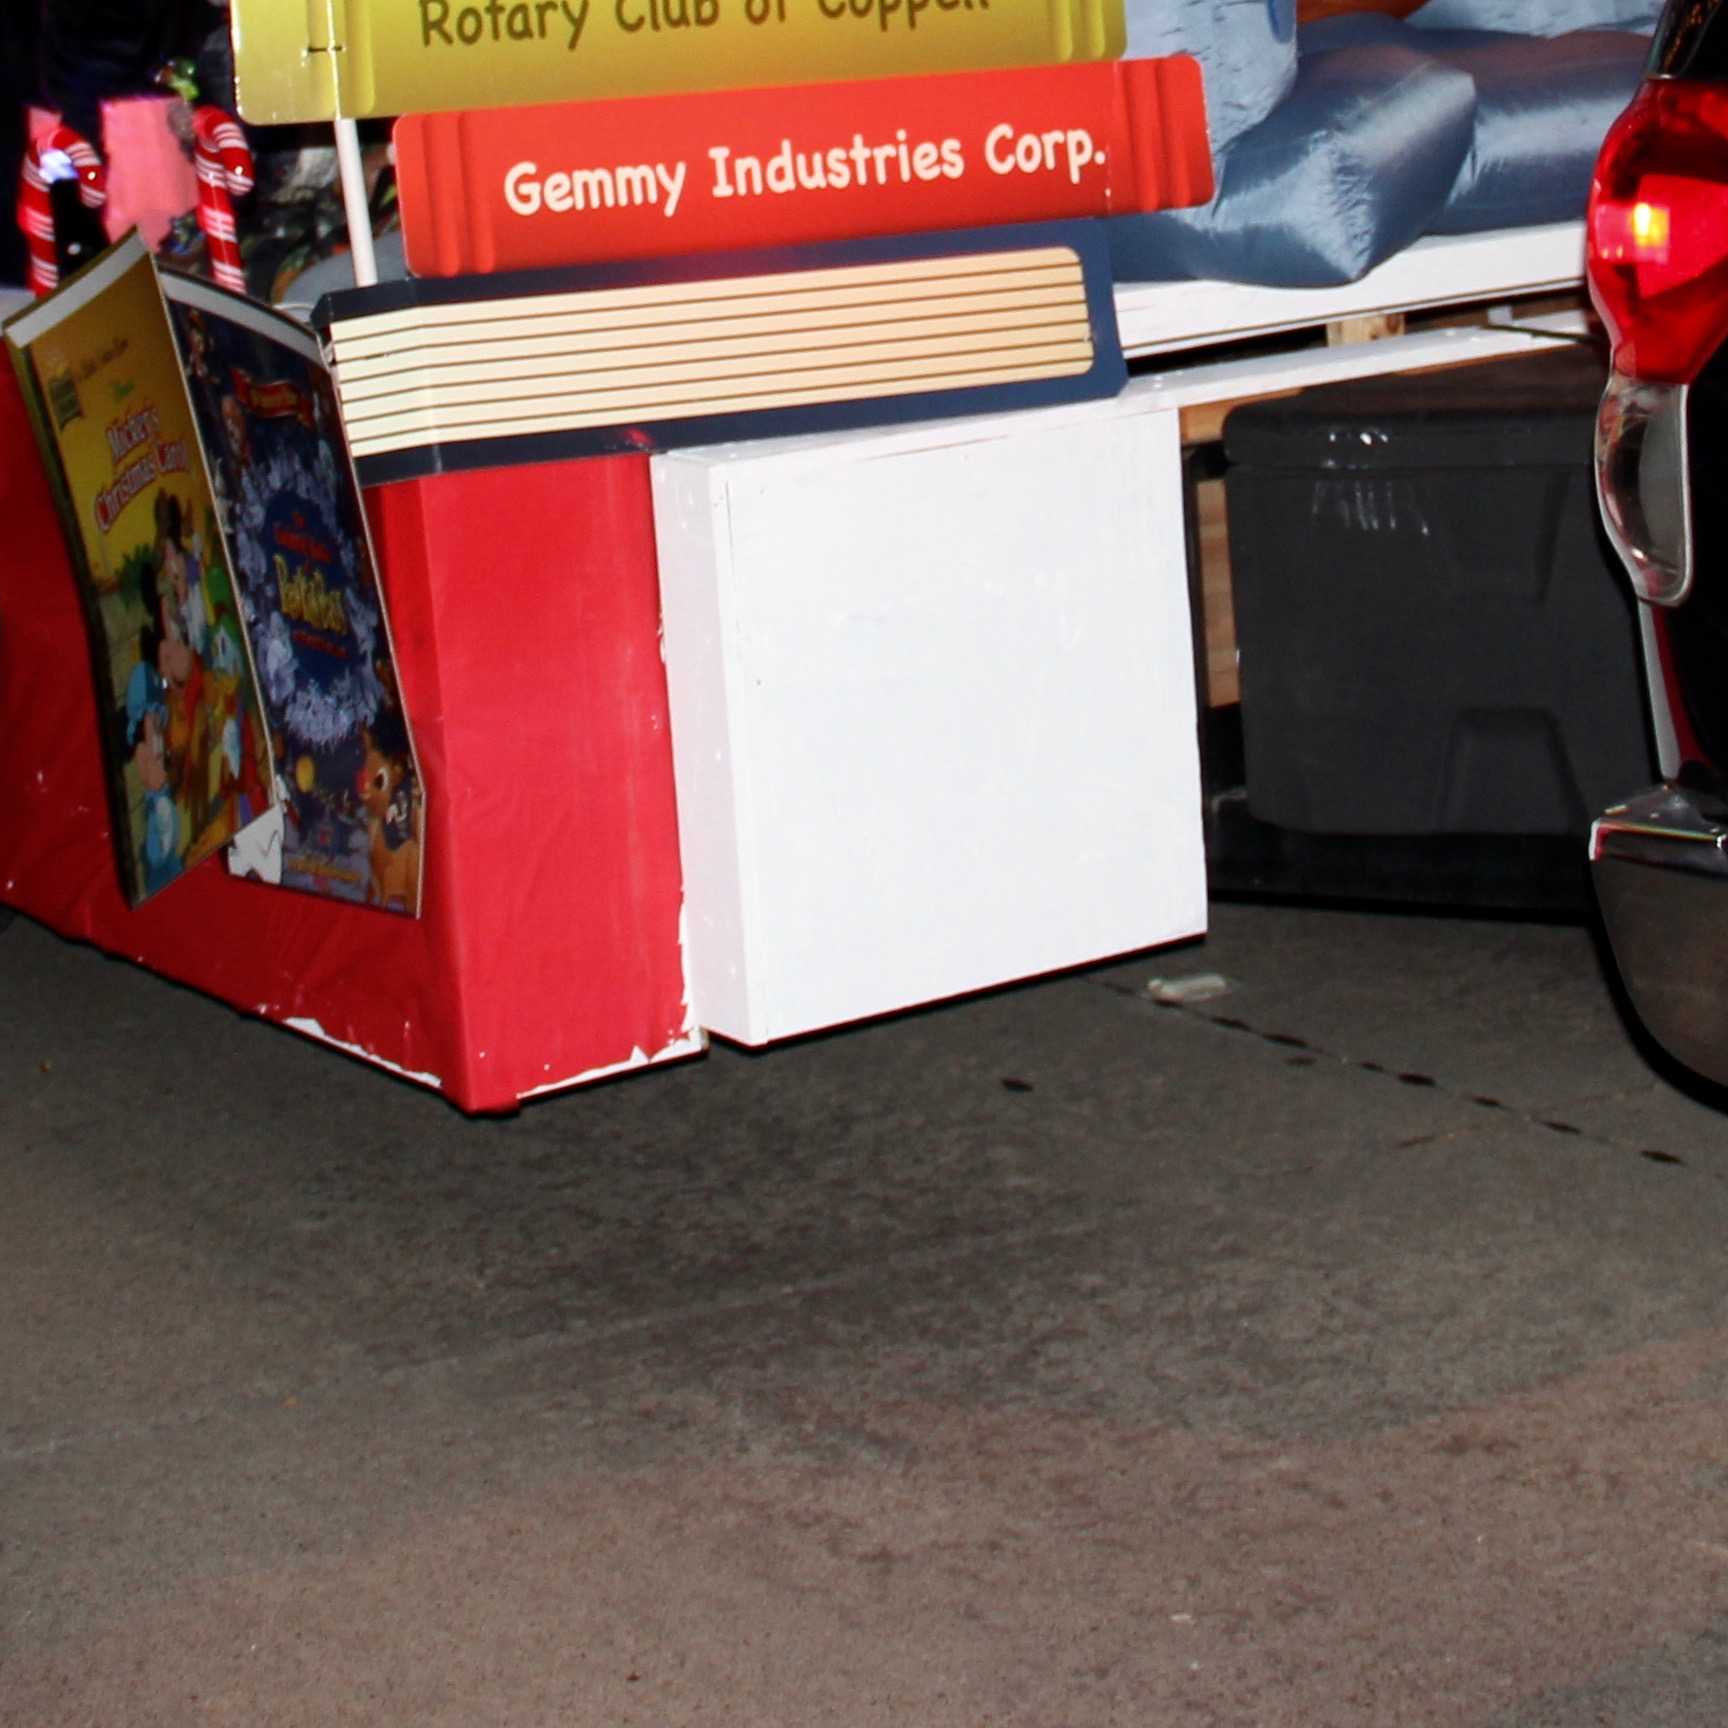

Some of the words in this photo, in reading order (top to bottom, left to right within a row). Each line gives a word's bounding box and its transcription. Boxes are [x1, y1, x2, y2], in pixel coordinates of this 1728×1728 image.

[504, 156, 686, 216] Gemmy
[710, 129, 964, 199] Industries
[984, 123, 1106, 185] Corp.
